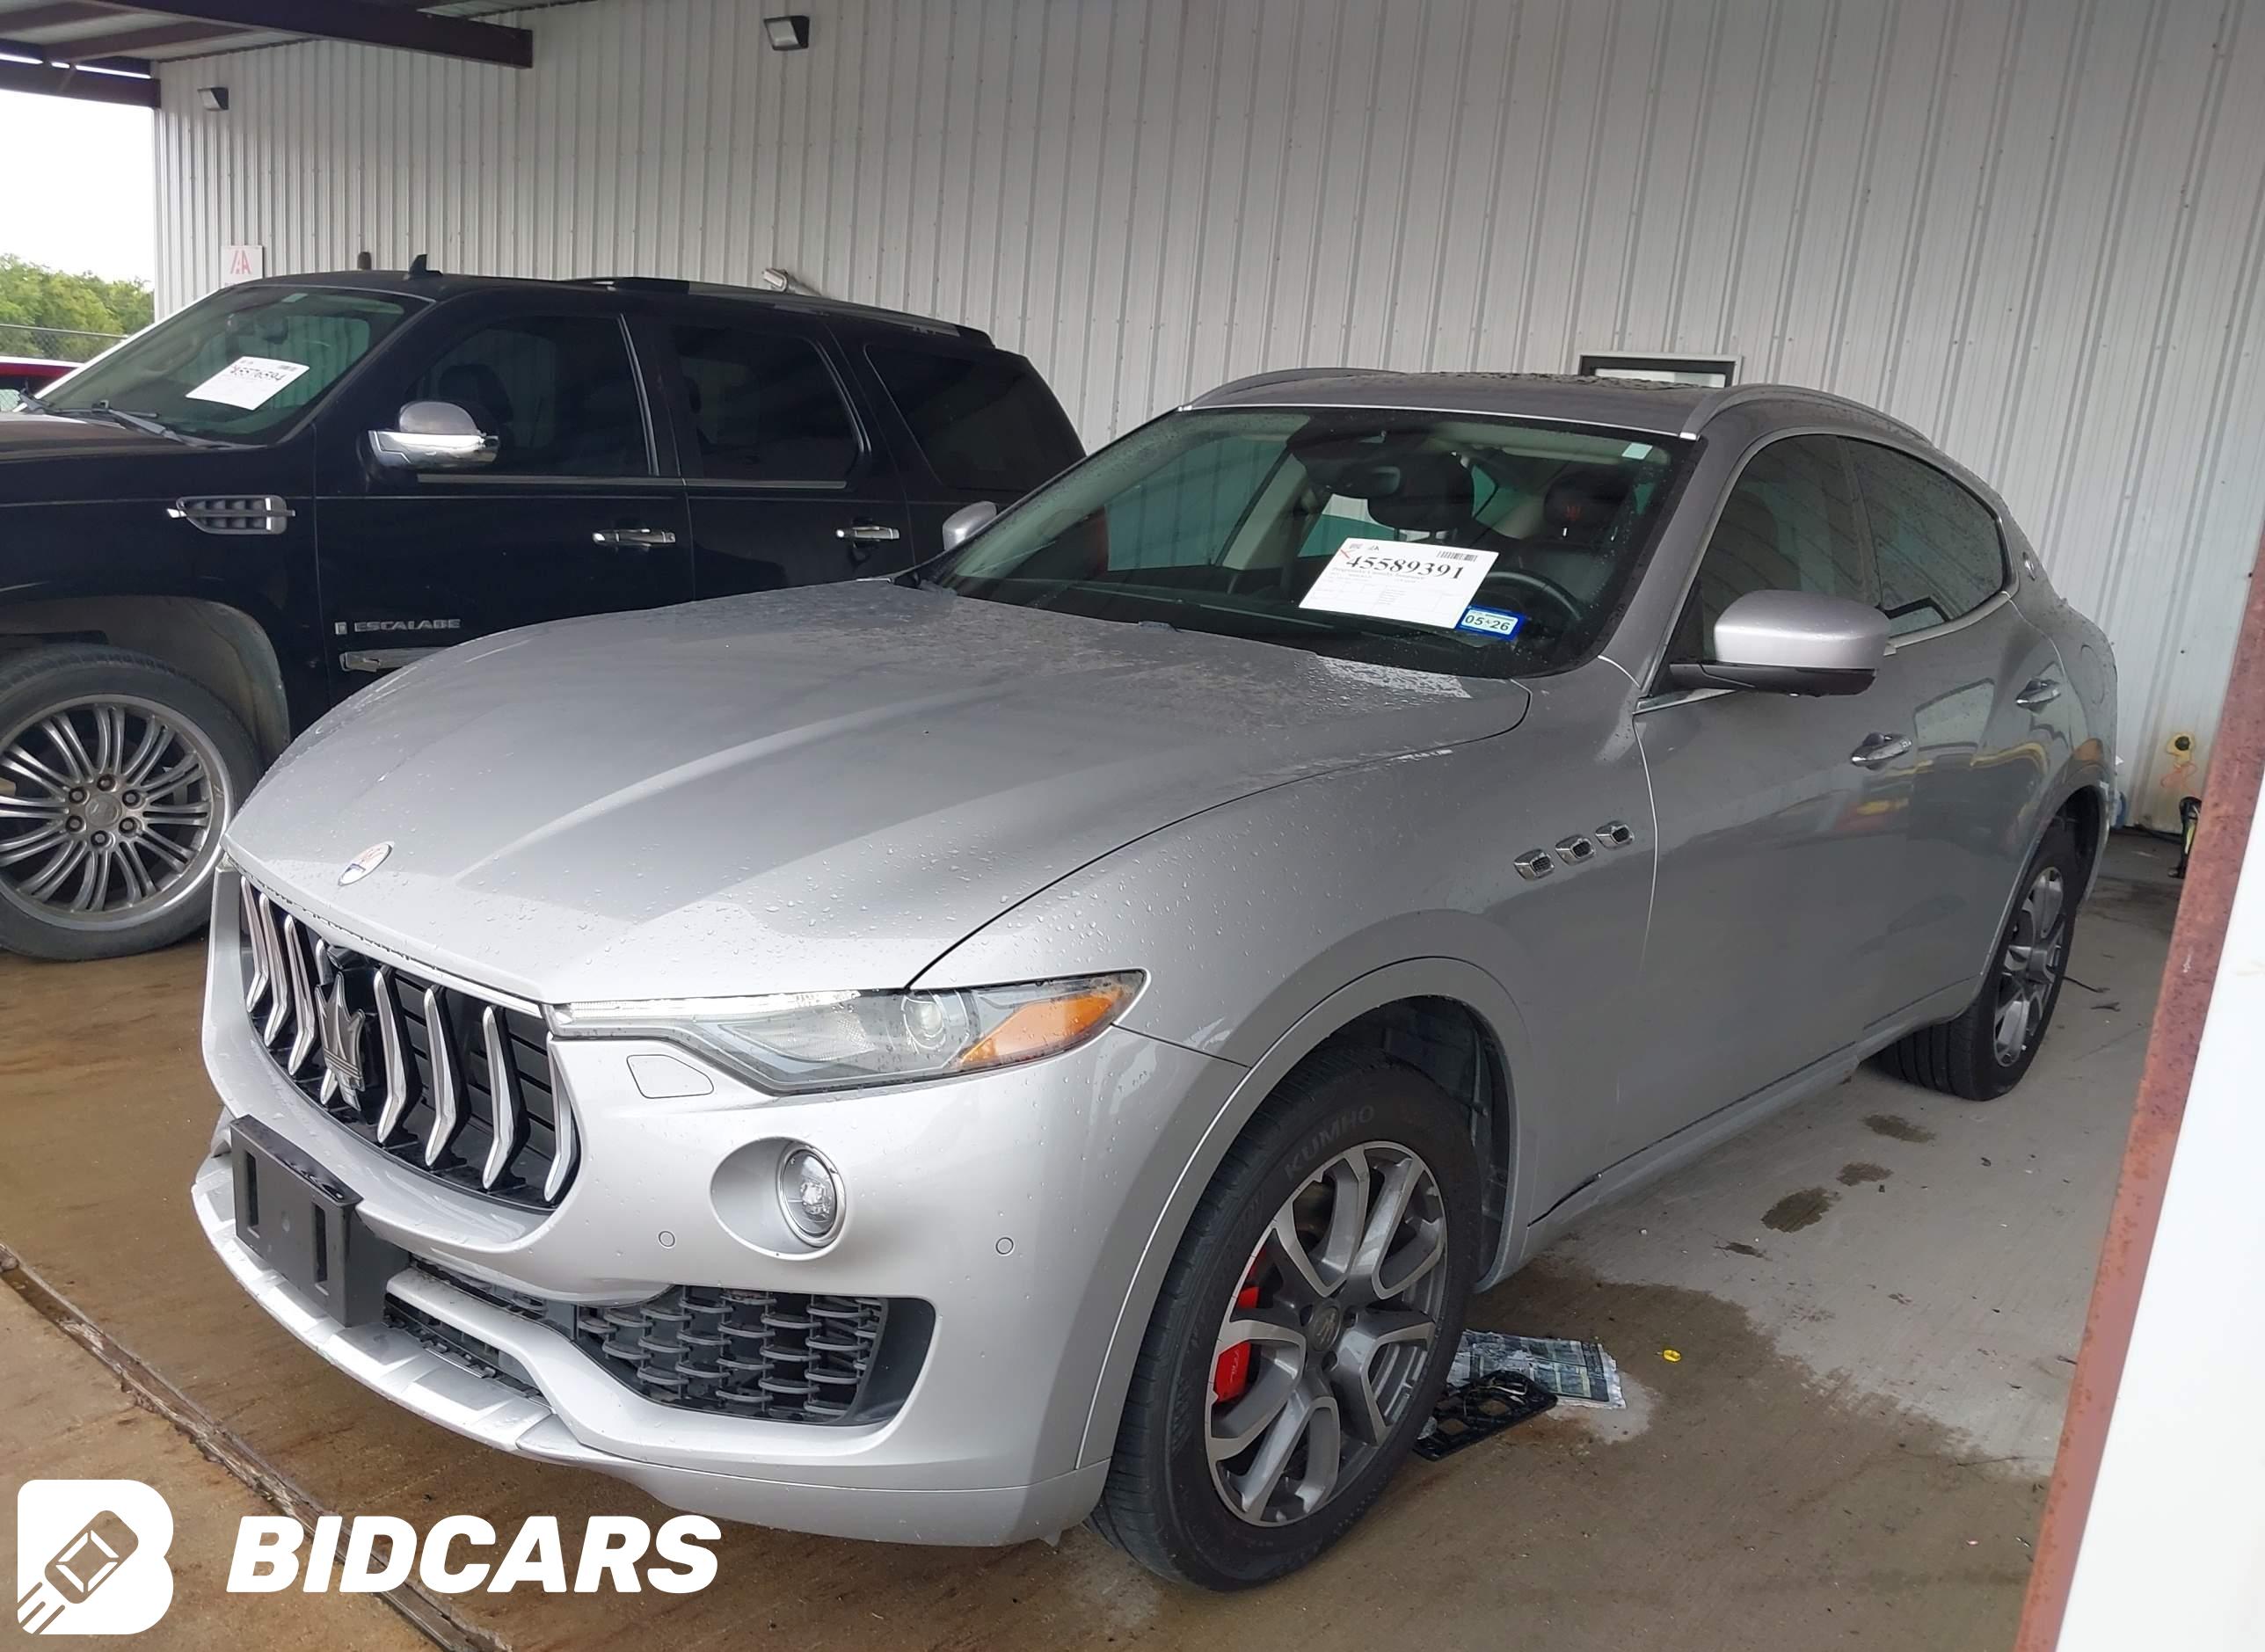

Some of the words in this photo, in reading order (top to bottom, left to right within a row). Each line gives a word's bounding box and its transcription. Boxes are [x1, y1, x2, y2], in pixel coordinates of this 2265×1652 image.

[1346, 555, 1466, 579] 45589391
[354, 619, 461, 632] ESCALADE
[1465, 615, 1484, 626] 05
[1489, 620, 1511, 631] 26
[1285, 1104, 1375, 1182] KUMHO
